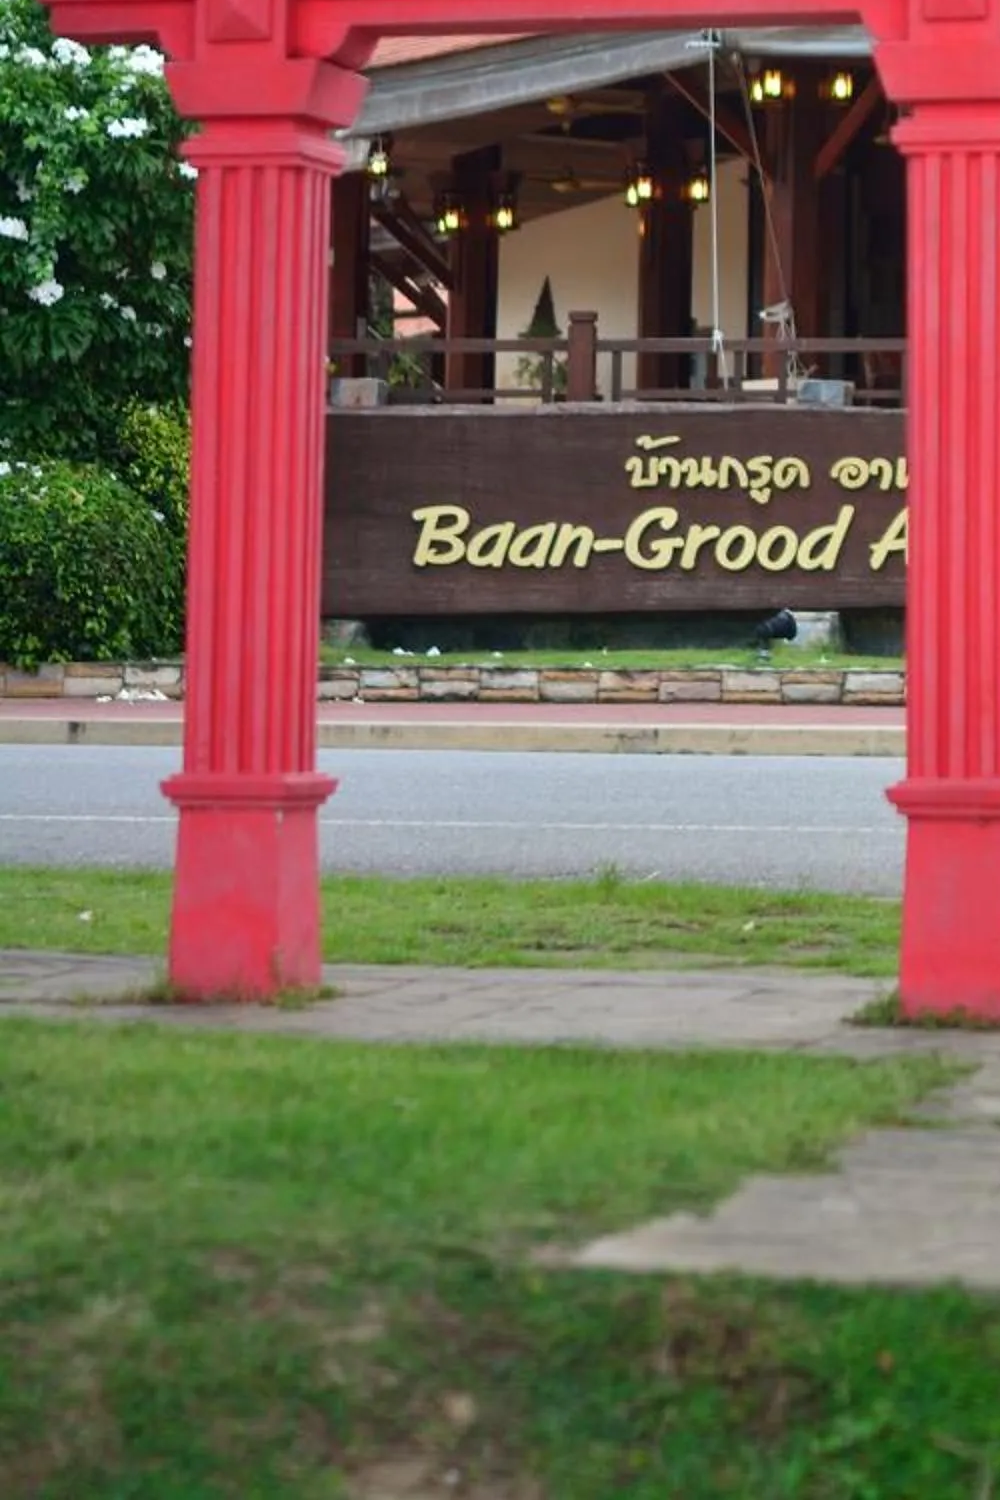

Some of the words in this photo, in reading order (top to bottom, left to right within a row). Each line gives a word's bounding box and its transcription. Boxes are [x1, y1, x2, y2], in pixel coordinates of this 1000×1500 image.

[625, 435, 810, 504] บ้านกรูด
[411, 504, 855, 571] Baan-Grood
